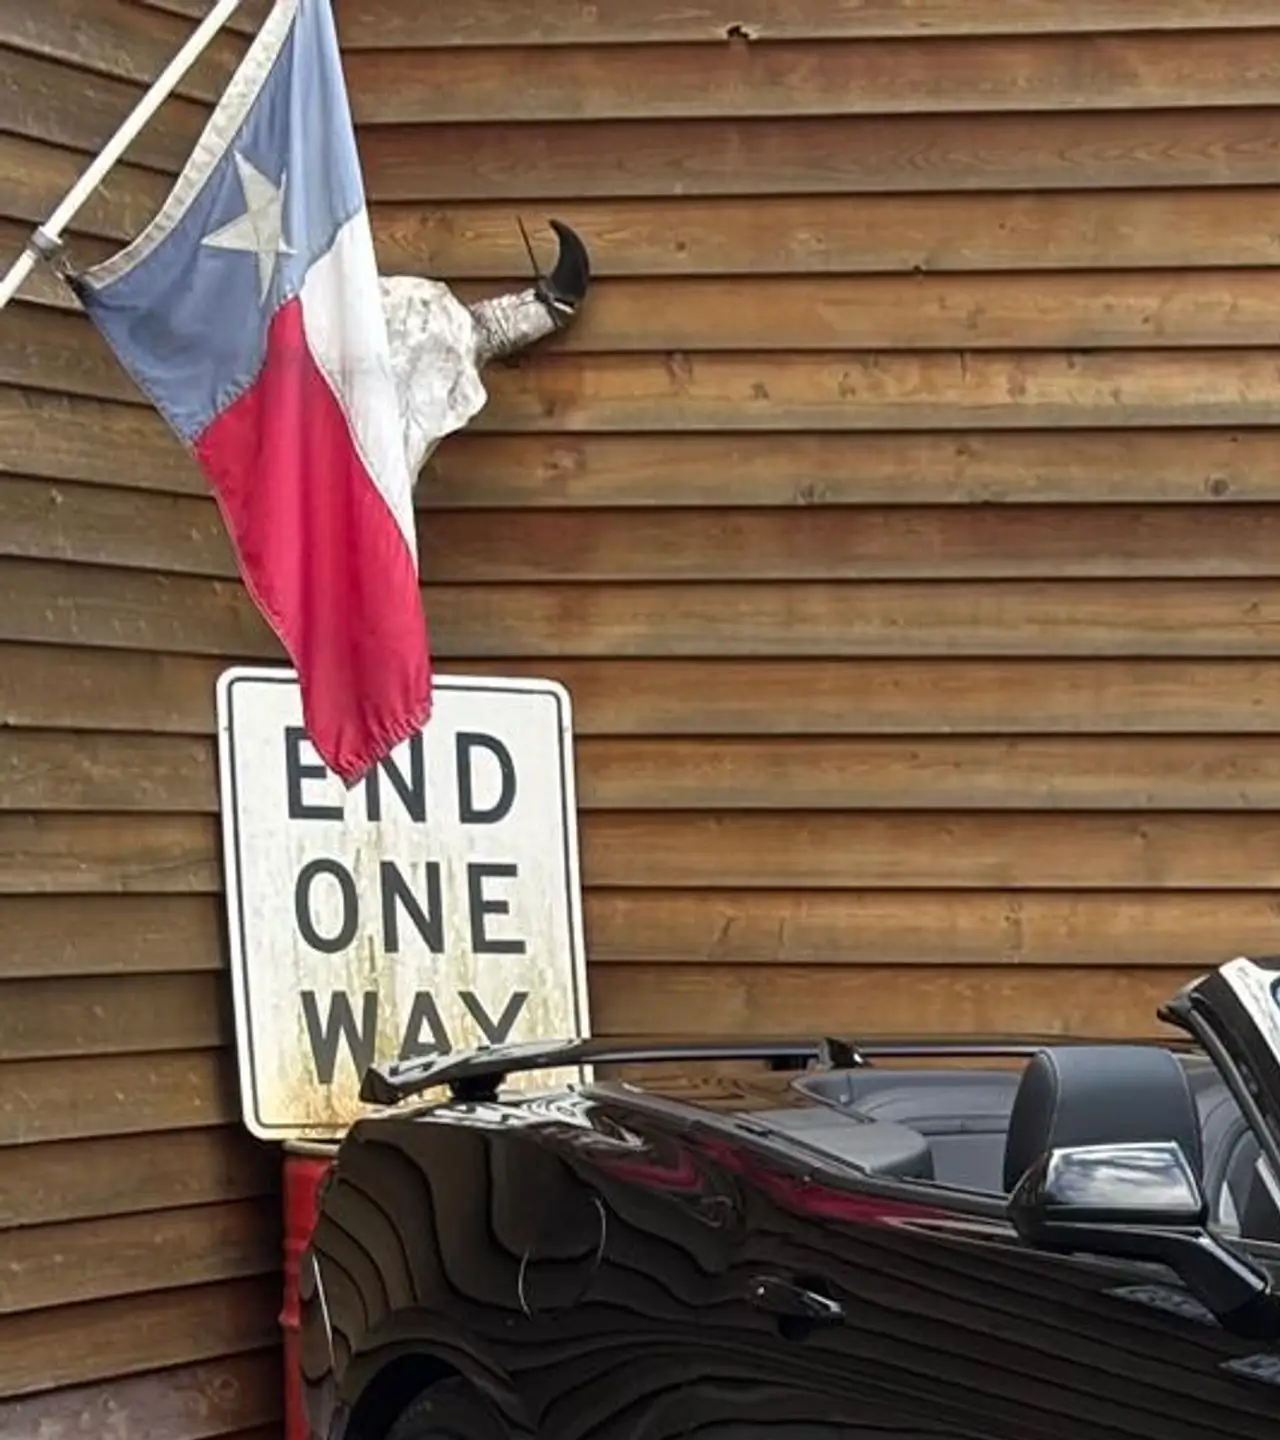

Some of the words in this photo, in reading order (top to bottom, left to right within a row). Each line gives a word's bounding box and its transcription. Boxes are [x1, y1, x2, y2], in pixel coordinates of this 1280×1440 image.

[284, 726, 517, 824] END
[294, 858, 527, 956] ONE
[299, 989, 530, 1086] WAY
